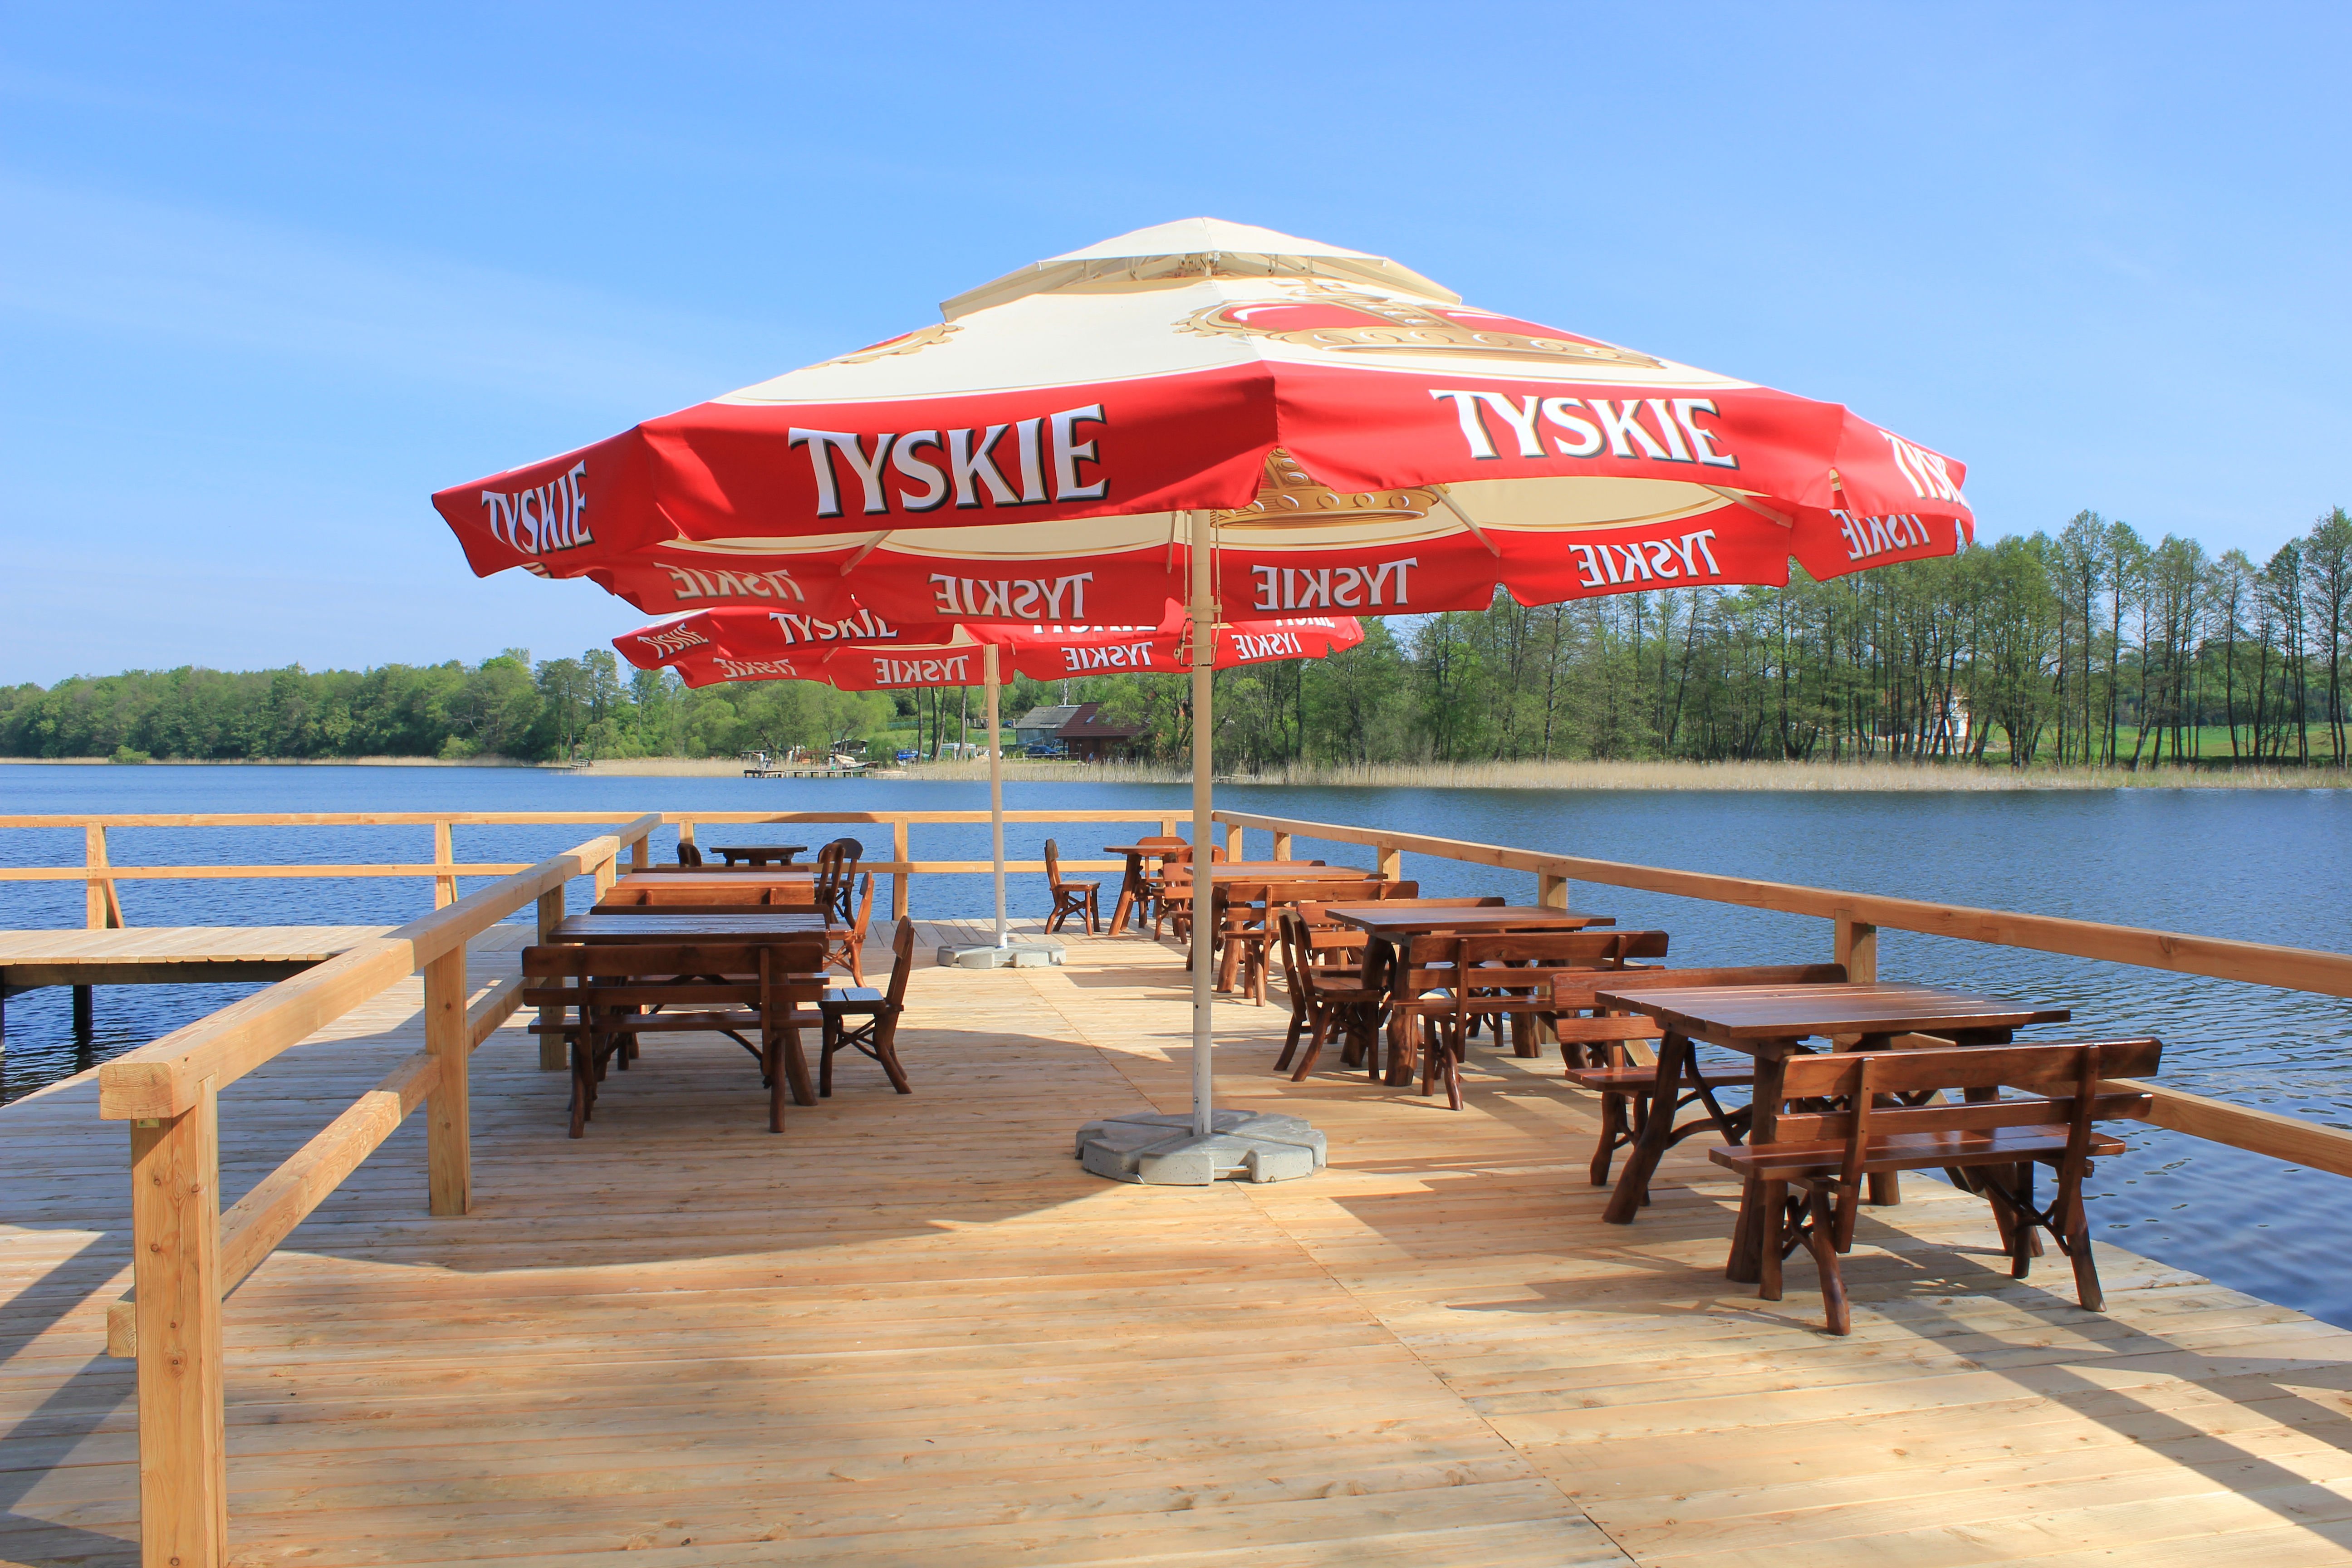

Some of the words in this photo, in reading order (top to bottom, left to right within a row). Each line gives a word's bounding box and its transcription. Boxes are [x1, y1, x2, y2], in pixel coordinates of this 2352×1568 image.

[788, 403, 1110, 519] TYSKIE
[1429, 389, 1740, 470] TYSKIE
[481, 460, 596, 555] TYSKIE
[637, 622, 710, 660] TYSKIE
